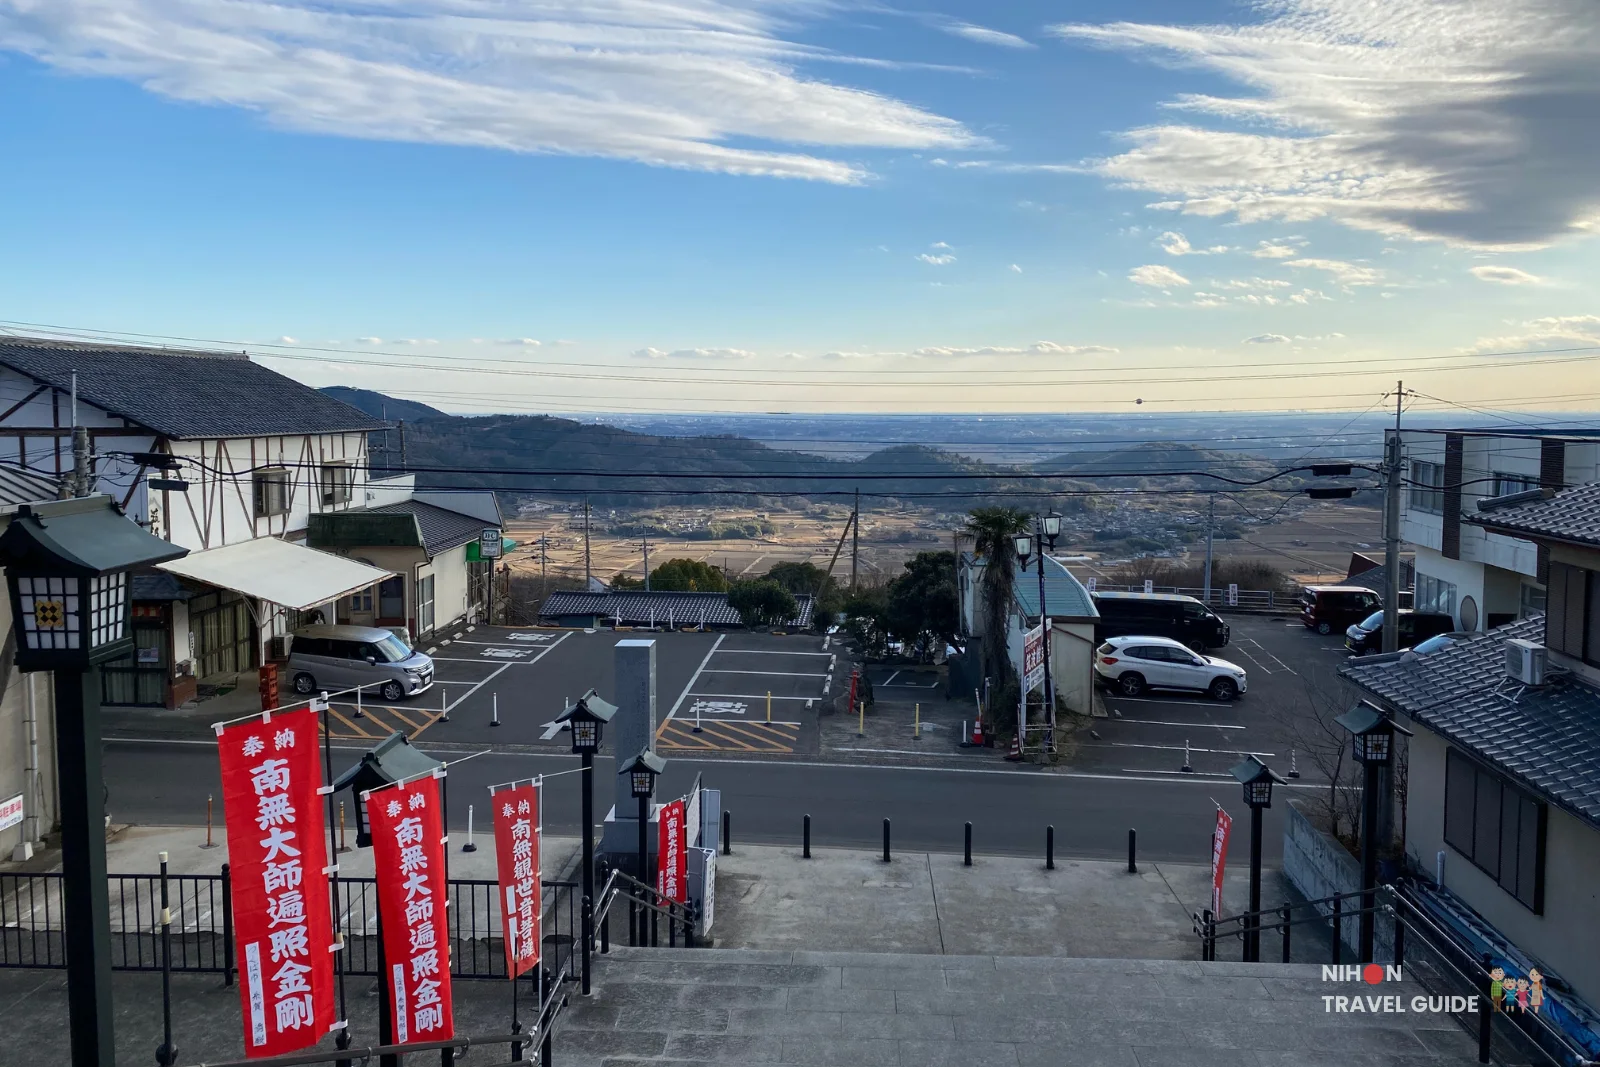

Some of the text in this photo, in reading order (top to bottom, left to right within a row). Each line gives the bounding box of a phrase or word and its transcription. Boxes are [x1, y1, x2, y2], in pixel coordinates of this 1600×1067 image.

[242, 728, 295, 757] 奉納
[386, 792, 426, 817] 奉納
[501, 799, 530, 817] 奉納
[249, 758, 315, 1034] 南無大師遍照金剛
[394, 817, 443, 1033] 南無大師遍照金剛
[510, 818, 535, 961] 南無観世音菩薩
